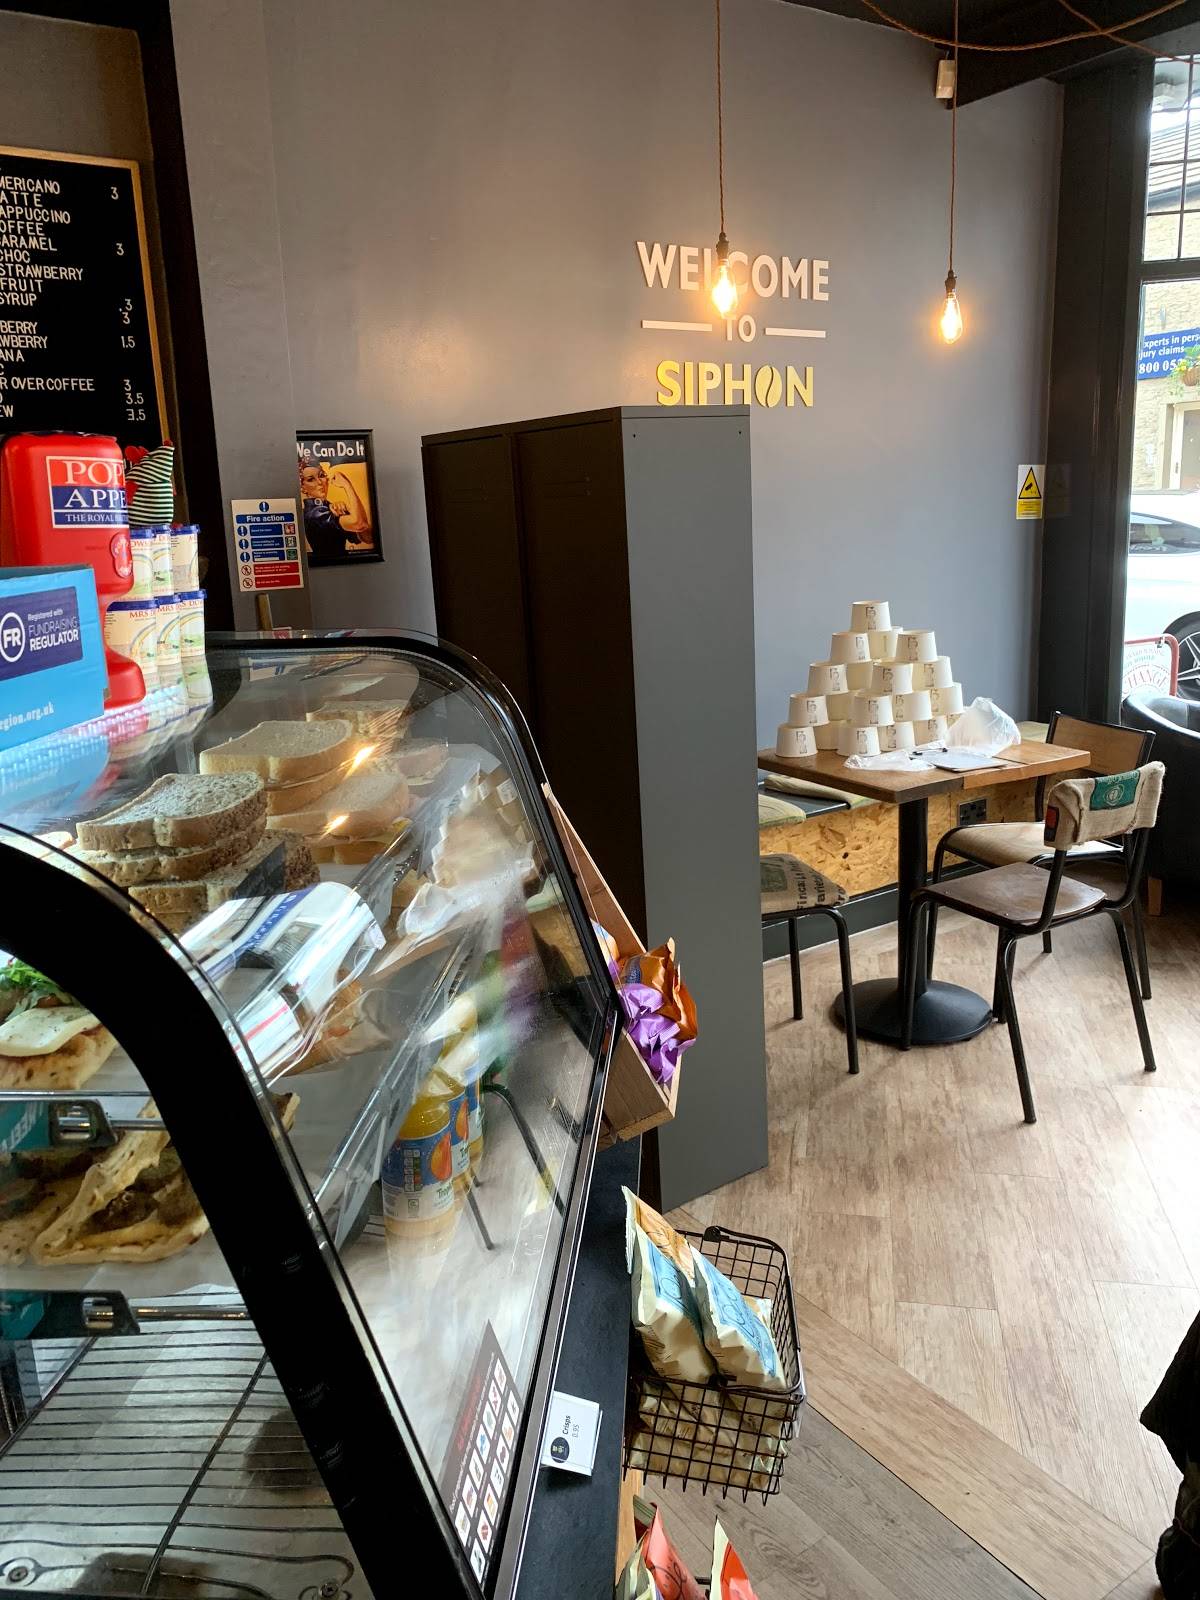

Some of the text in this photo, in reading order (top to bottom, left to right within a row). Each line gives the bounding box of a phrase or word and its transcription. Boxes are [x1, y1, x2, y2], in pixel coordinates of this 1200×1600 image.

[110, 186, 119, 200] 3
[0, 234, 57, 251] ARAMEL
[115, 242, 124, 256] 3
[0, 263, 83, 281] STRAWBERRY
[636, 240, 830, 302] WELCOME
[723, 313, 757, 343] TO
[0, 335, 48, 349] WBERRY
[121, 335, 136, 349] 1.5
[1158, 345, 1185, 356] claims
[11, 376, 45, 391] OVER
[46, 377, 96, 391] COFFEE
[123, 379, 132, 392] 3
[655, 359, 814, 408] SIPHON
[125, 392, 145, 405] 3.5
[312, 441, 336, 458] Can
[336, 441, 355, 457] Do
[355, 440, 365, 456] It
[65, 513, 88, 522] THE
[88, 513, 114, 522] ROYAL
[246, 515, 285, 523] Fire action
[28, 616, 79, 638] FUNDRAISING
[3, 628, 22, 649] FR
[30, 629, 79, 652] REGULATOR
[562, 1415, 571, 1435] Crisps
